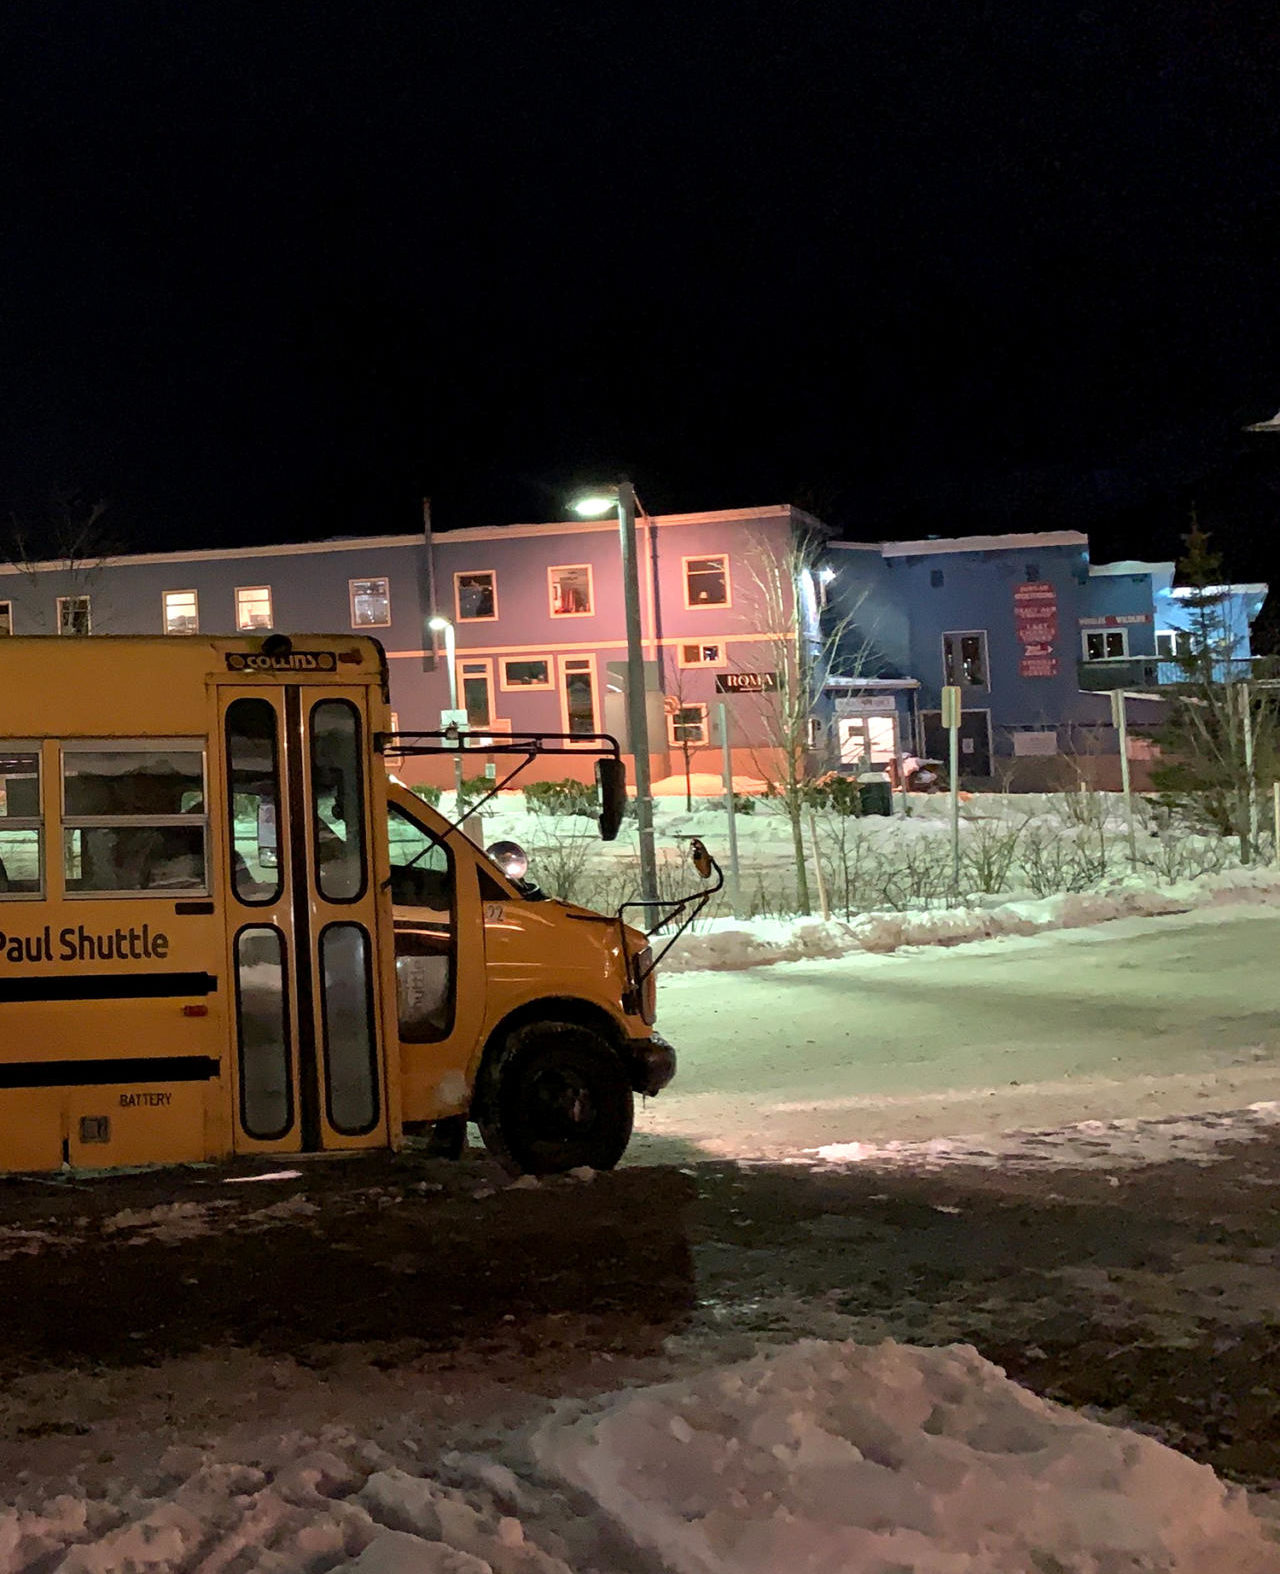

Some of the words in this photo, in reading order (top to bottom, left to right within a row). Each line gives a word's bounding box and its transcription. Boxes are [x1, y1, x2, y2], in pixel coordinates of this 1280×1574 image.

[728, 674, 773, 687] ROMA
[59, 923, 169, 961] Shuttle
[120, 1092, 172, 1107] BATTERY
